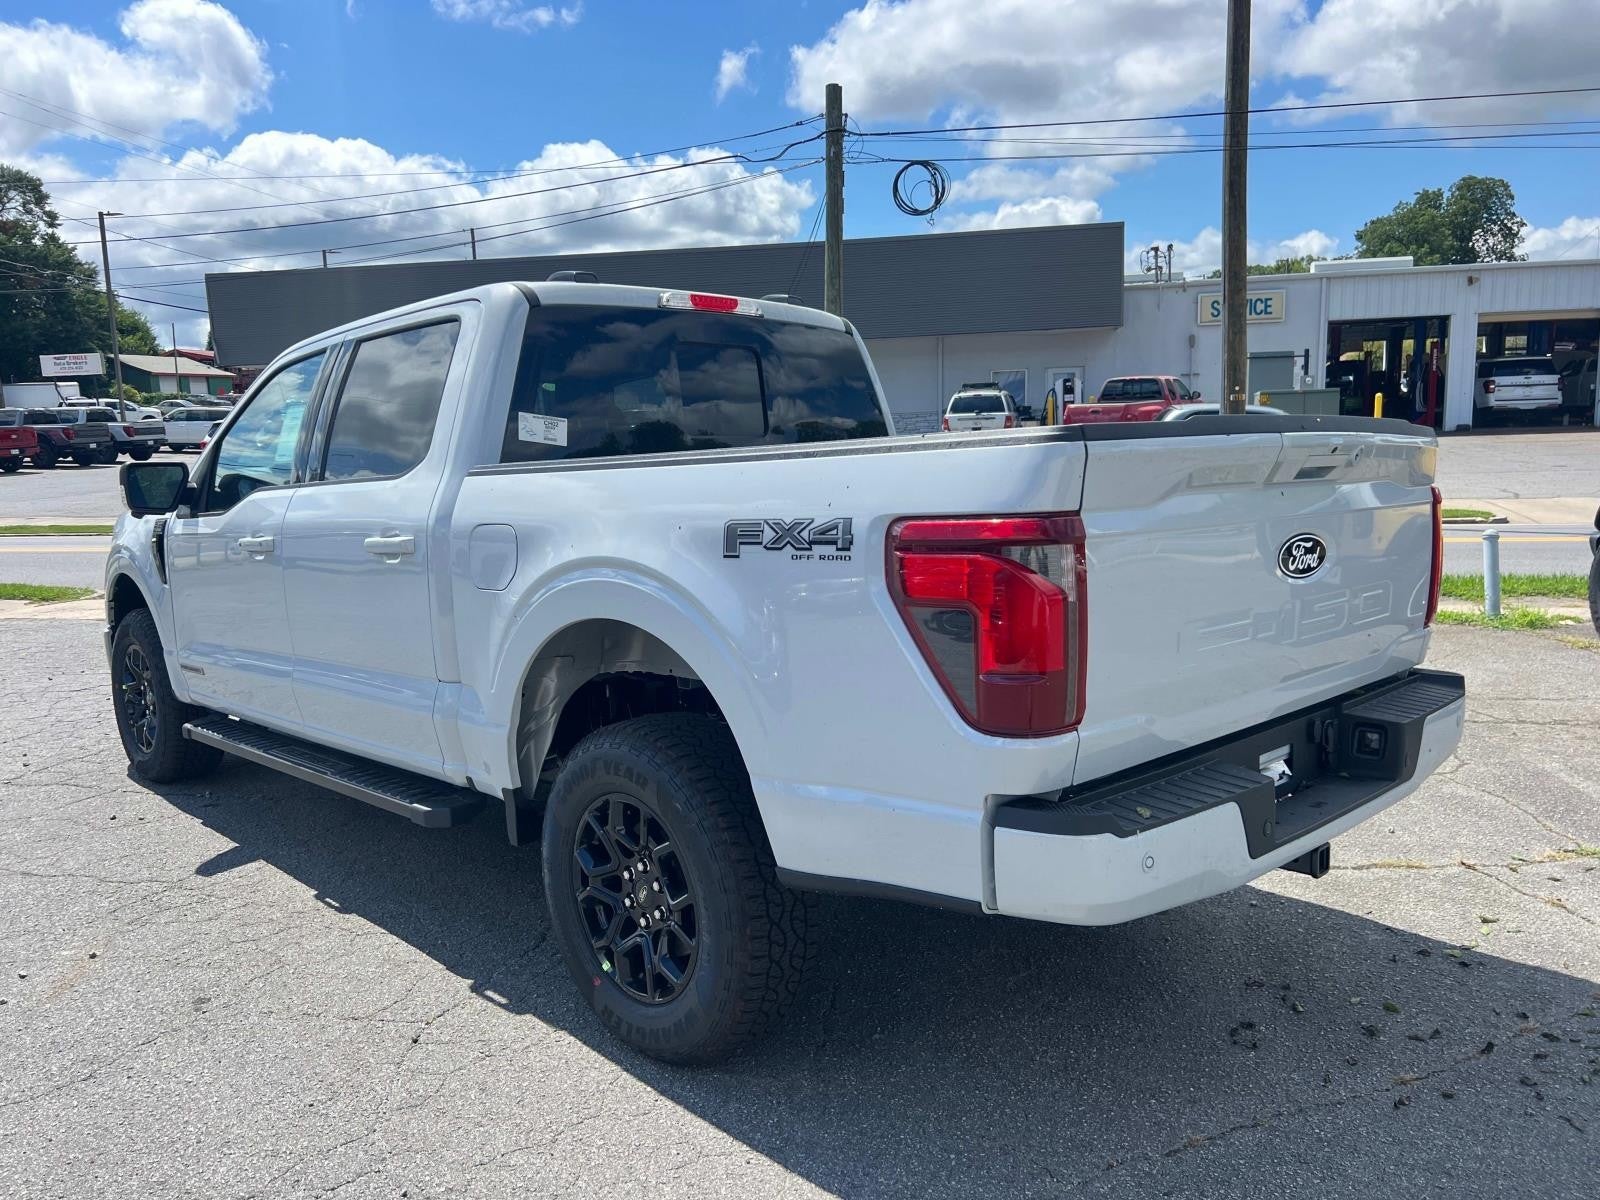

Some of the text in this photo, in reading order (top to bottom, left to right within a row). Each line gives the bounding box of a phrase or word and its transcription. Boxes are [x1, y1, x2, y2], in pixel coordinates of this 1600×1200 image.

[1211, 298, 1272, 318] SICE
[723, 517, 853, 558] FX4
[1288, 541, 1320, 571] Ford
